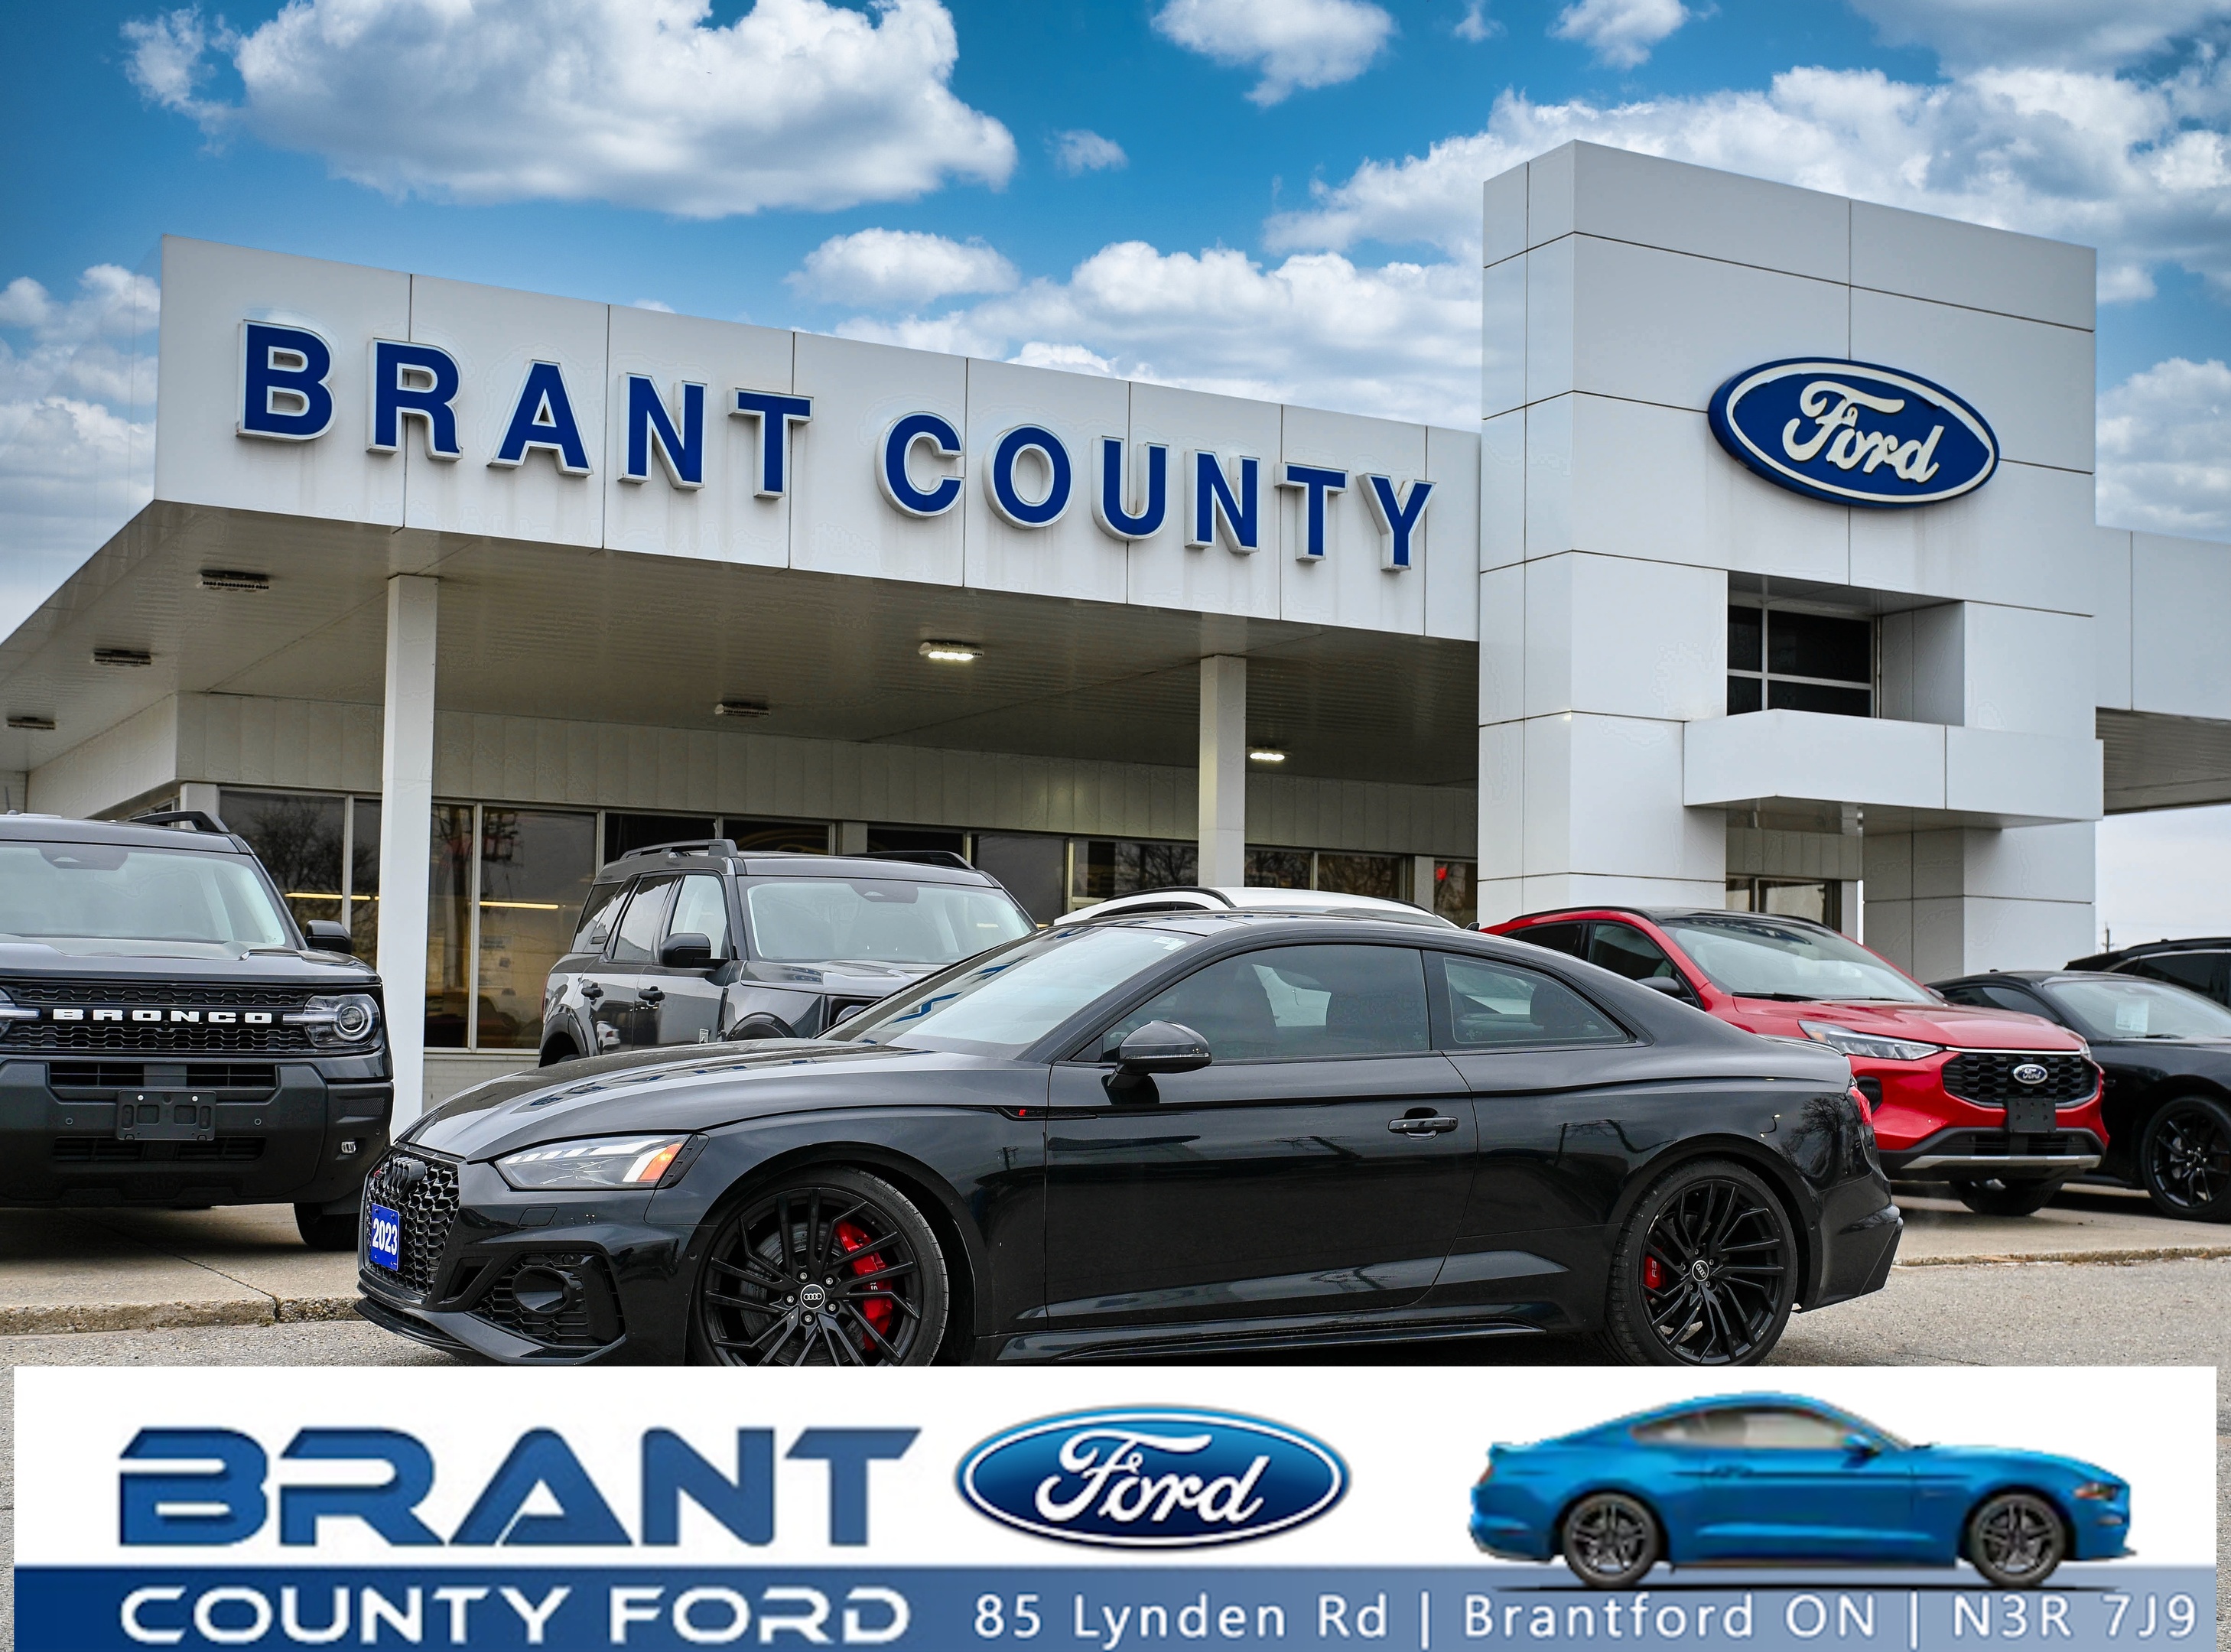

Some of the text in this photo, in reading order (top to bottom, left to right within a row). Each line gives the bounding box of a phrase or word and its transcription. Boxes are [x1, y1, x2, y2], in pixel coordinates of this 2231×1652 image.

[236, 319, 1437, 572] BRANT COUNTY
[1782, 381, 1945, 483] Ford
[53, 1008, 272, 1024] BRONCO
[372, 1218, 398, 1256] 2023
[1651, 1260, 1657, 1278] RS
